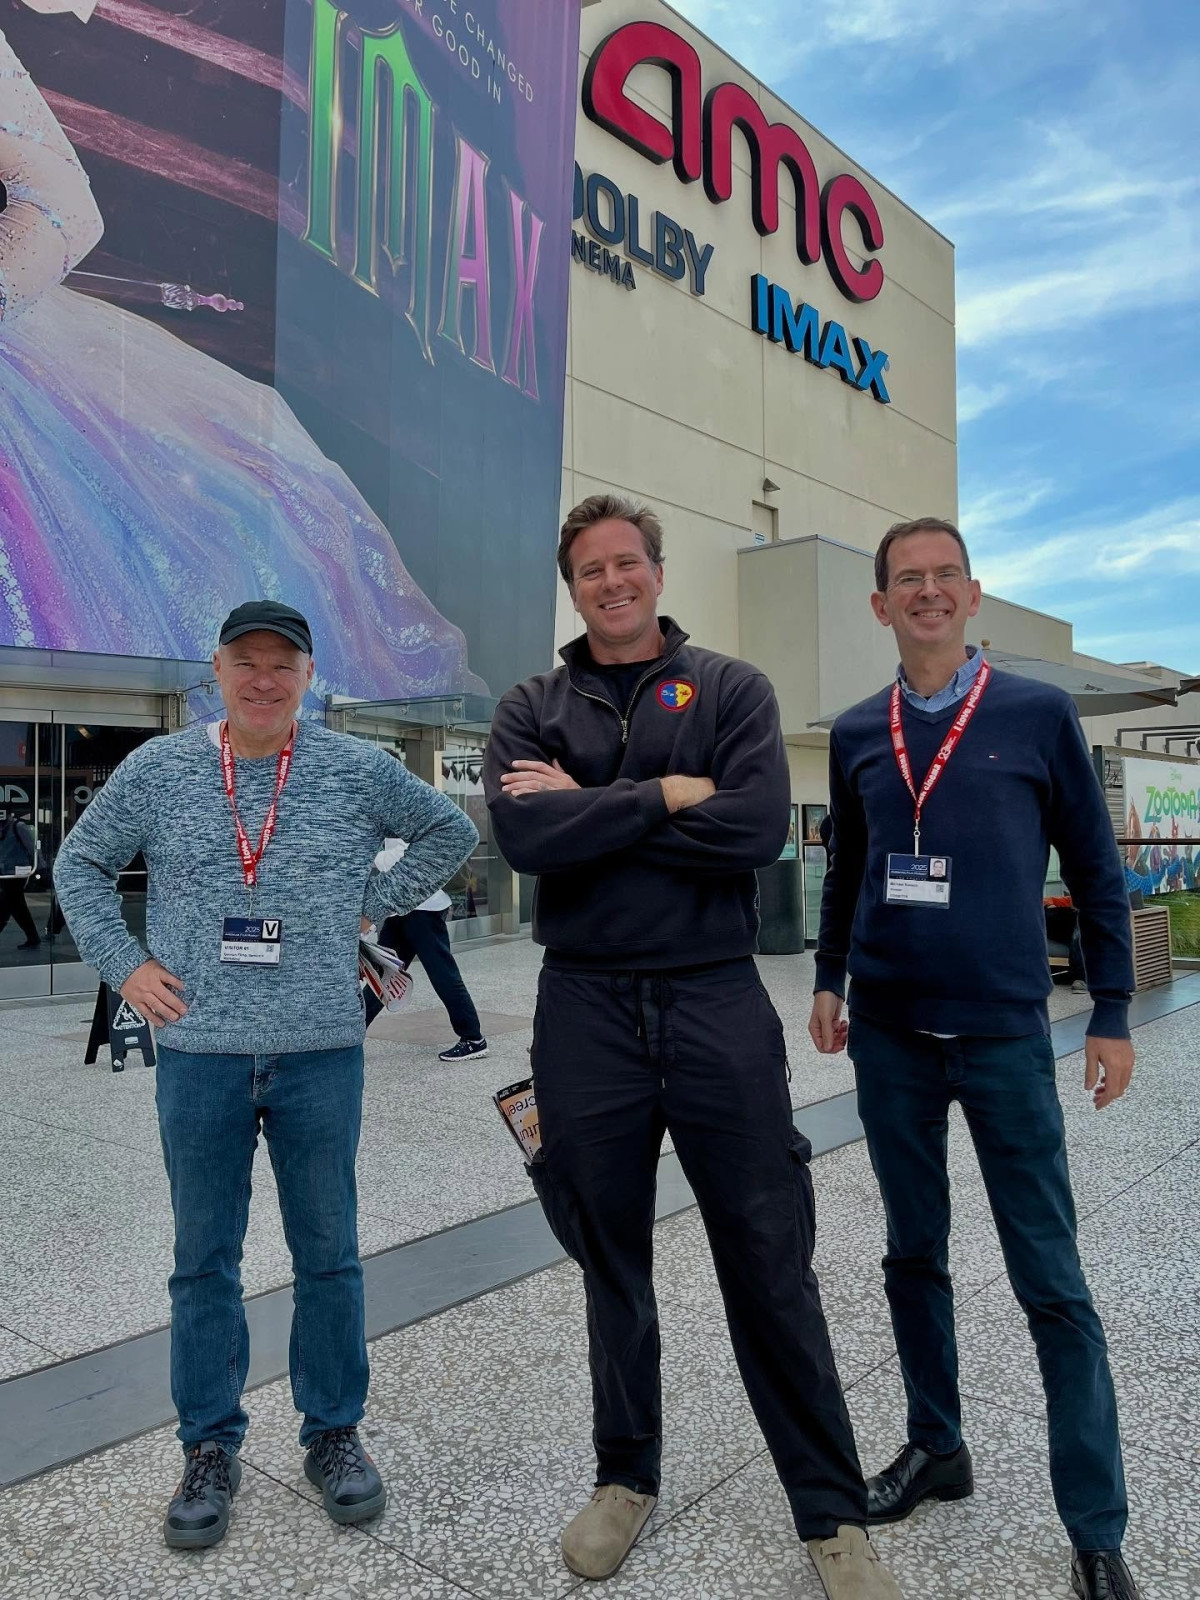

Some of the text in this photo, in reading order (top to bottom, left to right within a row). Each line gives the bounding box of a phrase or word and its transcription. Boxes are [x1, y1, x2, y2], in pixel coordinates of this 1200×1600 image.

[432, 14, 480, 79] GOOD
[487, 75, 501, 104] IN
[465, 12, 533, 102] CHANGED
[303, 0, 546, 404] IMAX
[571, 229, 637, 291] NEMA
[751, 273, 890, 403] IMAX
[1144, 785, 1198, 823] ZOOTOPIA
[911, 863, 928, 871] 2025
[264, 922, 277, 937] V
